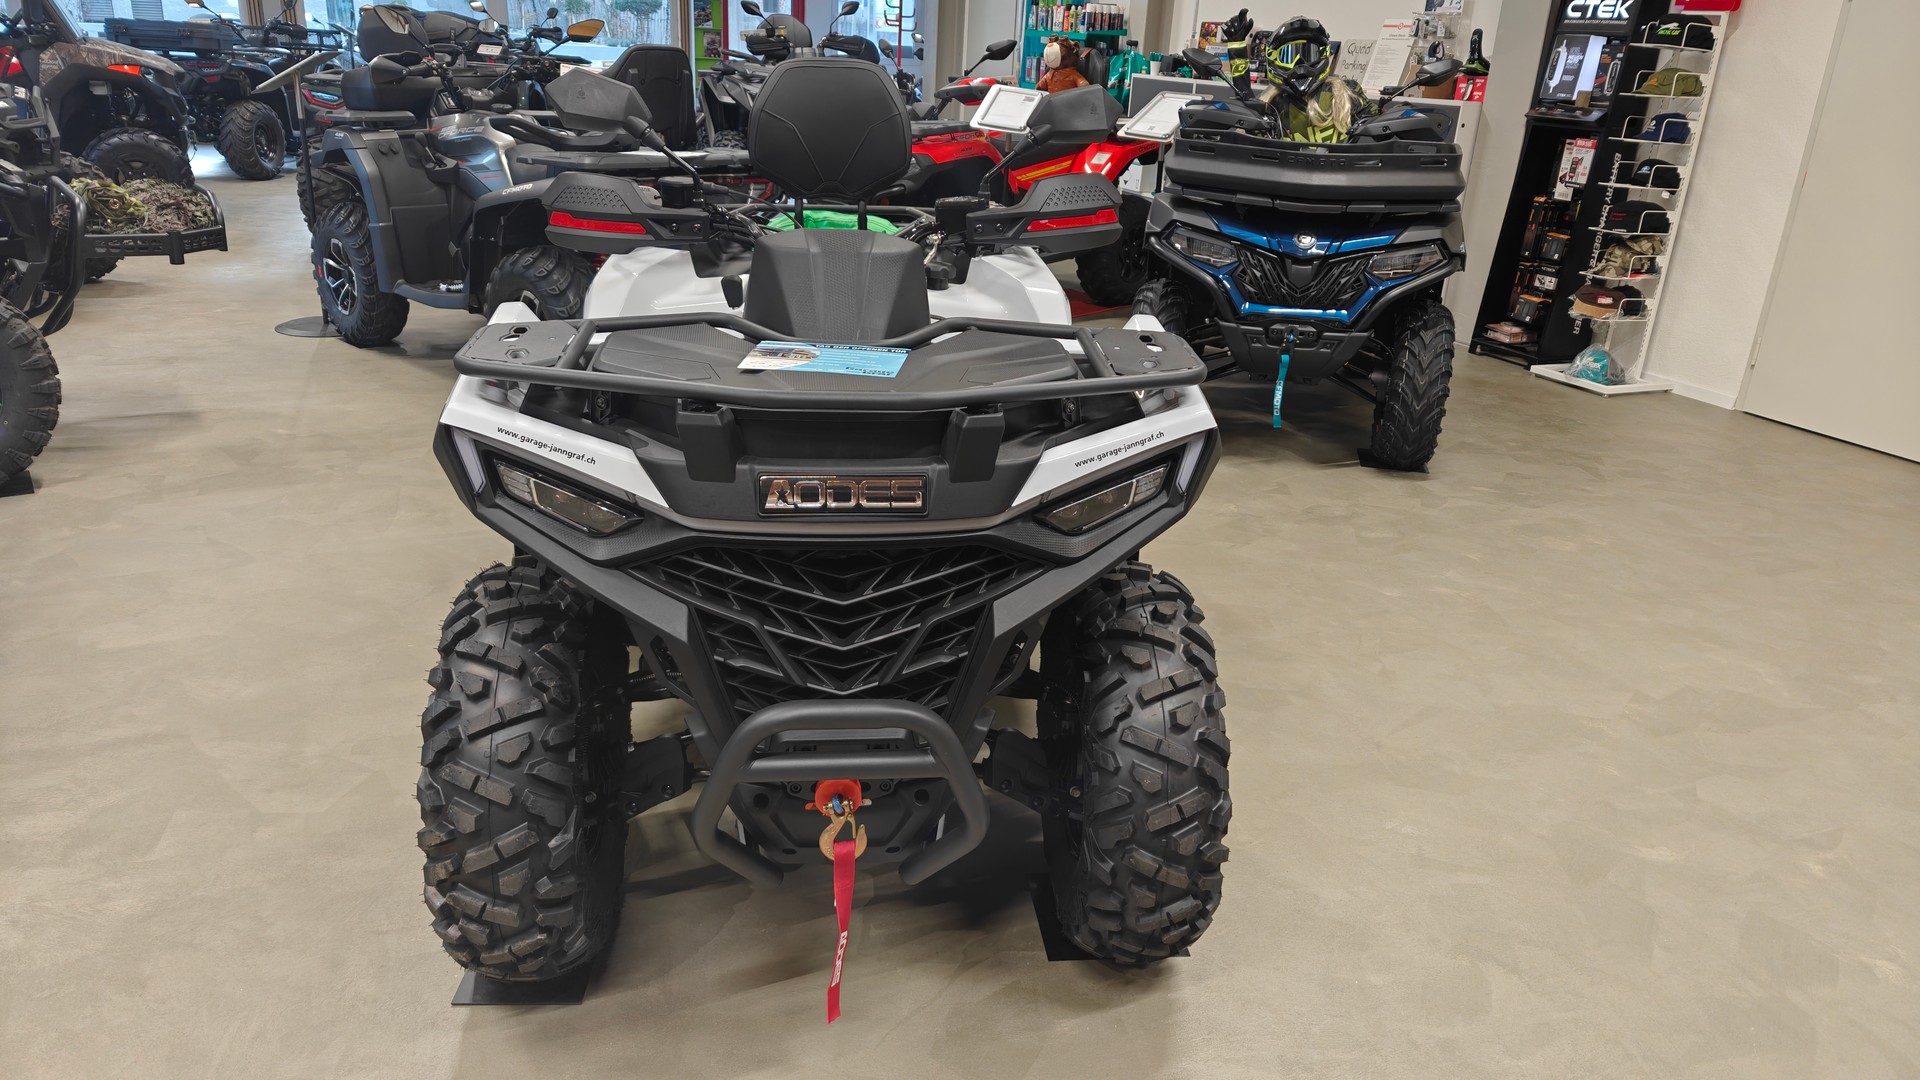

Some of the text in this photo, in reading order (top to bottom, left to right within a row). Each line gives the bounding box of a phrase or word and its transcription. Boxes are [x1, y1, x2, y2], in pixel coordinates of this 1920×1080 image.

[1566, 0, 1634, 19] CTEK
[1347, 42, 1374, 56] Quad
[1342, 60, 1367, 74] Parking
[502, 183, 533, 195] CFMOTO
[1273, 380, 1284, 416] CFMOTO
[497, 426, 596, 465] www.garage-janngraf.ch
[1074, 431, 1165, 468] www.garage-janngraf.ch
[764, 479, 923, 509] AODES
